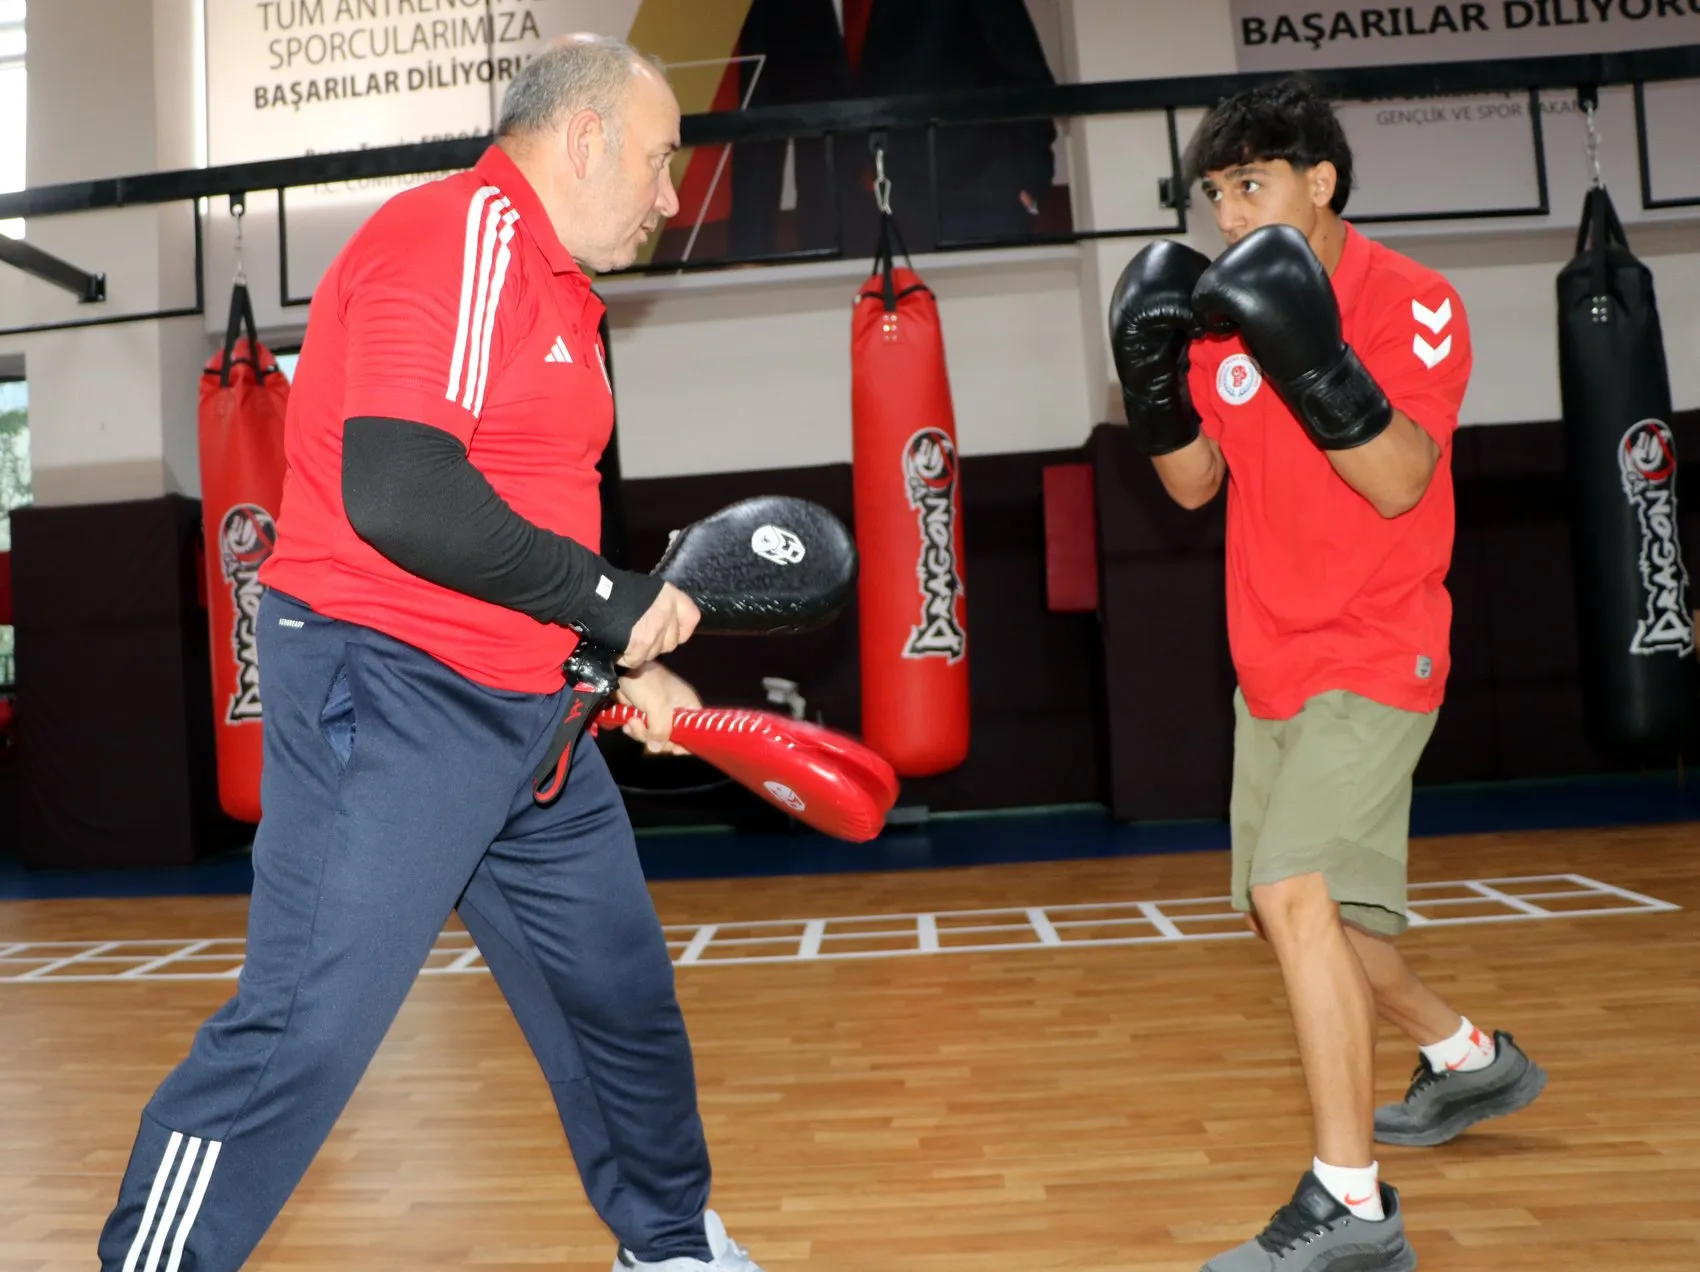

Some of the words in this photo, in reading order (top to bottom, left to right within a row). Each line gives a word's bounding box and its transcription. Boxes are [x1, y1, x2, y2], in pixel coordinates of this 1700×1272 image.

[268, 10, 540, 70] SPORCULARIMIZA
[1241, 2, 1489, 49] BAŞARILAR
[254, 70, 400, 111] BAŞARILAR
[1451, 105, 1471, 120] VE
[1478, 102, 1523, 119] SPOR
[913, 497, 963, 654] DRAGON
[1642, 489, 1692, 644] DRAGON
